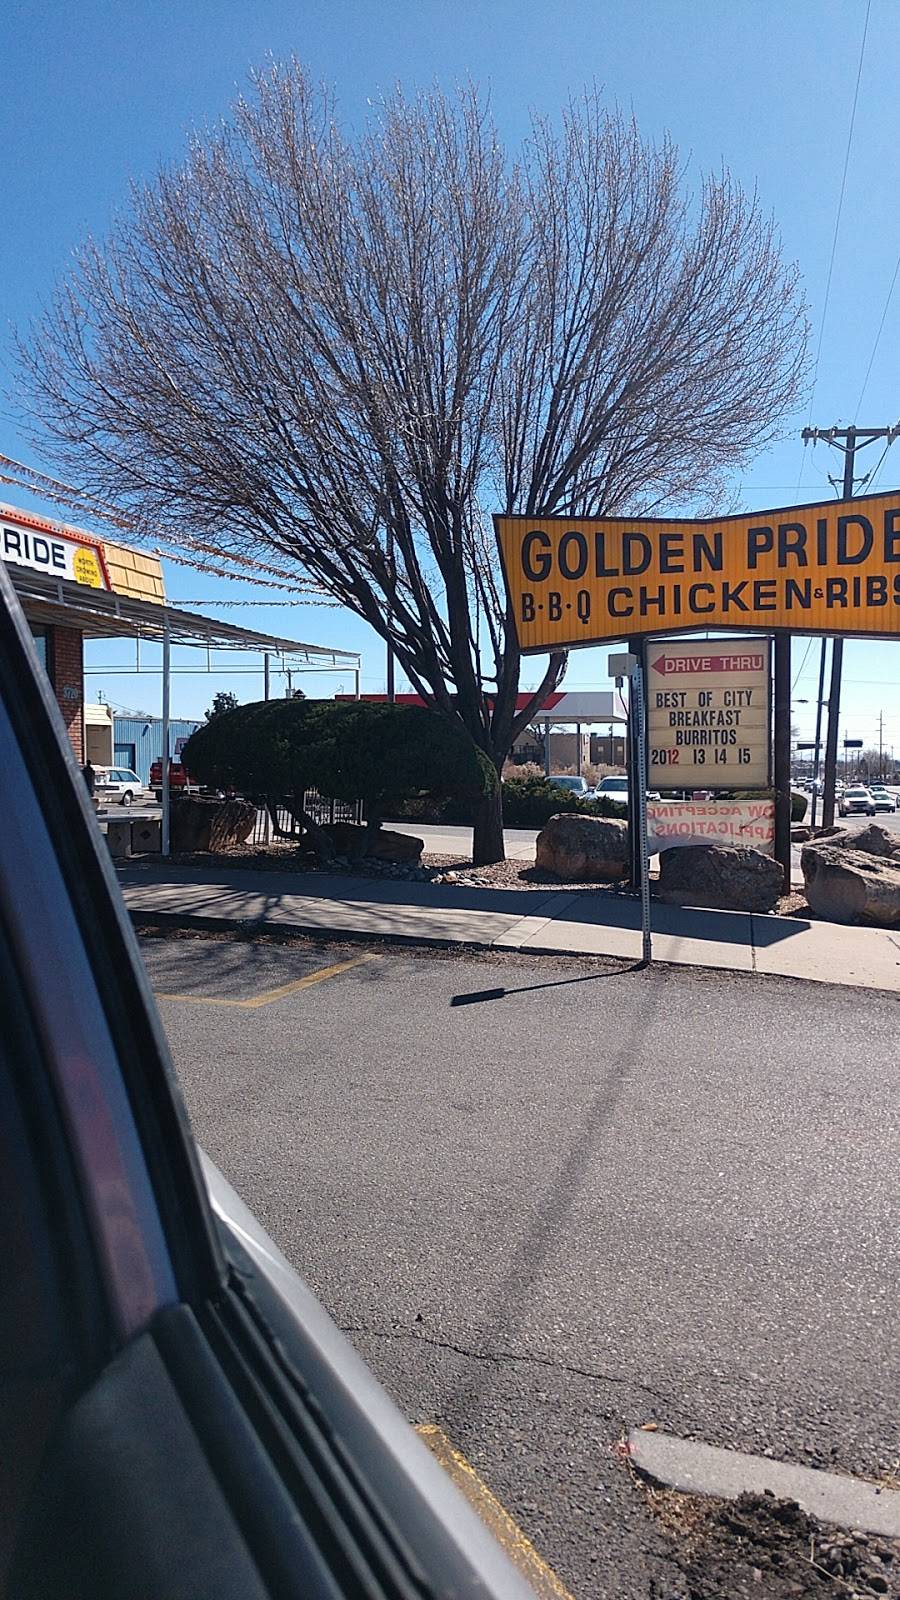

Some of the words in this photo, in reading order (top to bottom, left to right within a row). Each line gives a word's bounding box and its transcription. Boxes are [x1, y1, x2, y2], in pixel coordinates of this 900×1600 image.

[0, 528, 67, 570] RIDE
[521, 530, 723, 582] GOLDEN
[607, 578, 812, 618] CHICKEN
[813, 588, 824, 599] &
[664, 657, 711, 672] DRIVE
[720, 655, 763, 670] THRU
[656, 692, 687, 708] BEST
[698, 691, 713, 707] OF
[724, 690, 752, 706] CITY
[669, 710, 741, 727] BREAKFAST
[676, 729, 737, 745] BURRITOS
[651, 749, 679, 765] 2012
[693, 749, 705, 764] 13
[714, 749, 727, 764] 14
[738, 748, 751, 764] 15
